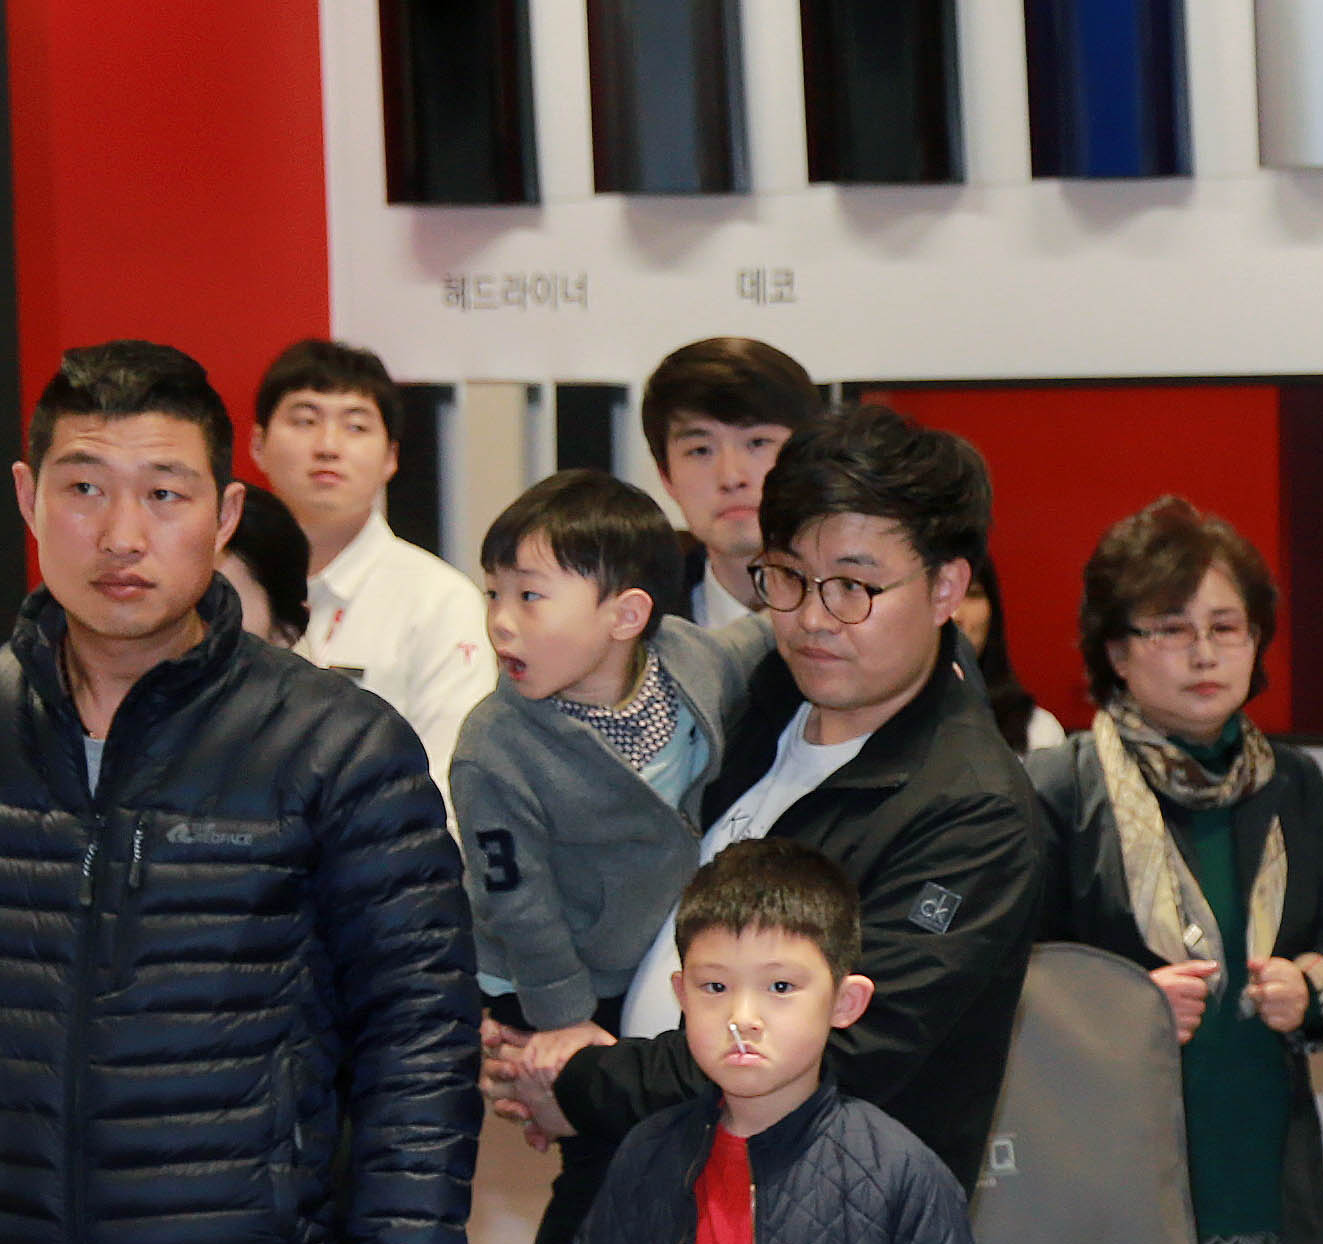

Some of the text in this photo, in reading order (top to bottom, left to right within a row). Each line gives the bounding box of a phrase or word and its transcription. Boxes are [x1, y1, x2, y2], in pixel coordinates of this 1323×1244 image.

[443, 271, 589, 311] 헤드라이너
[736, 266, 798, 305] 데코
[476, 828, 520, 892] 3
